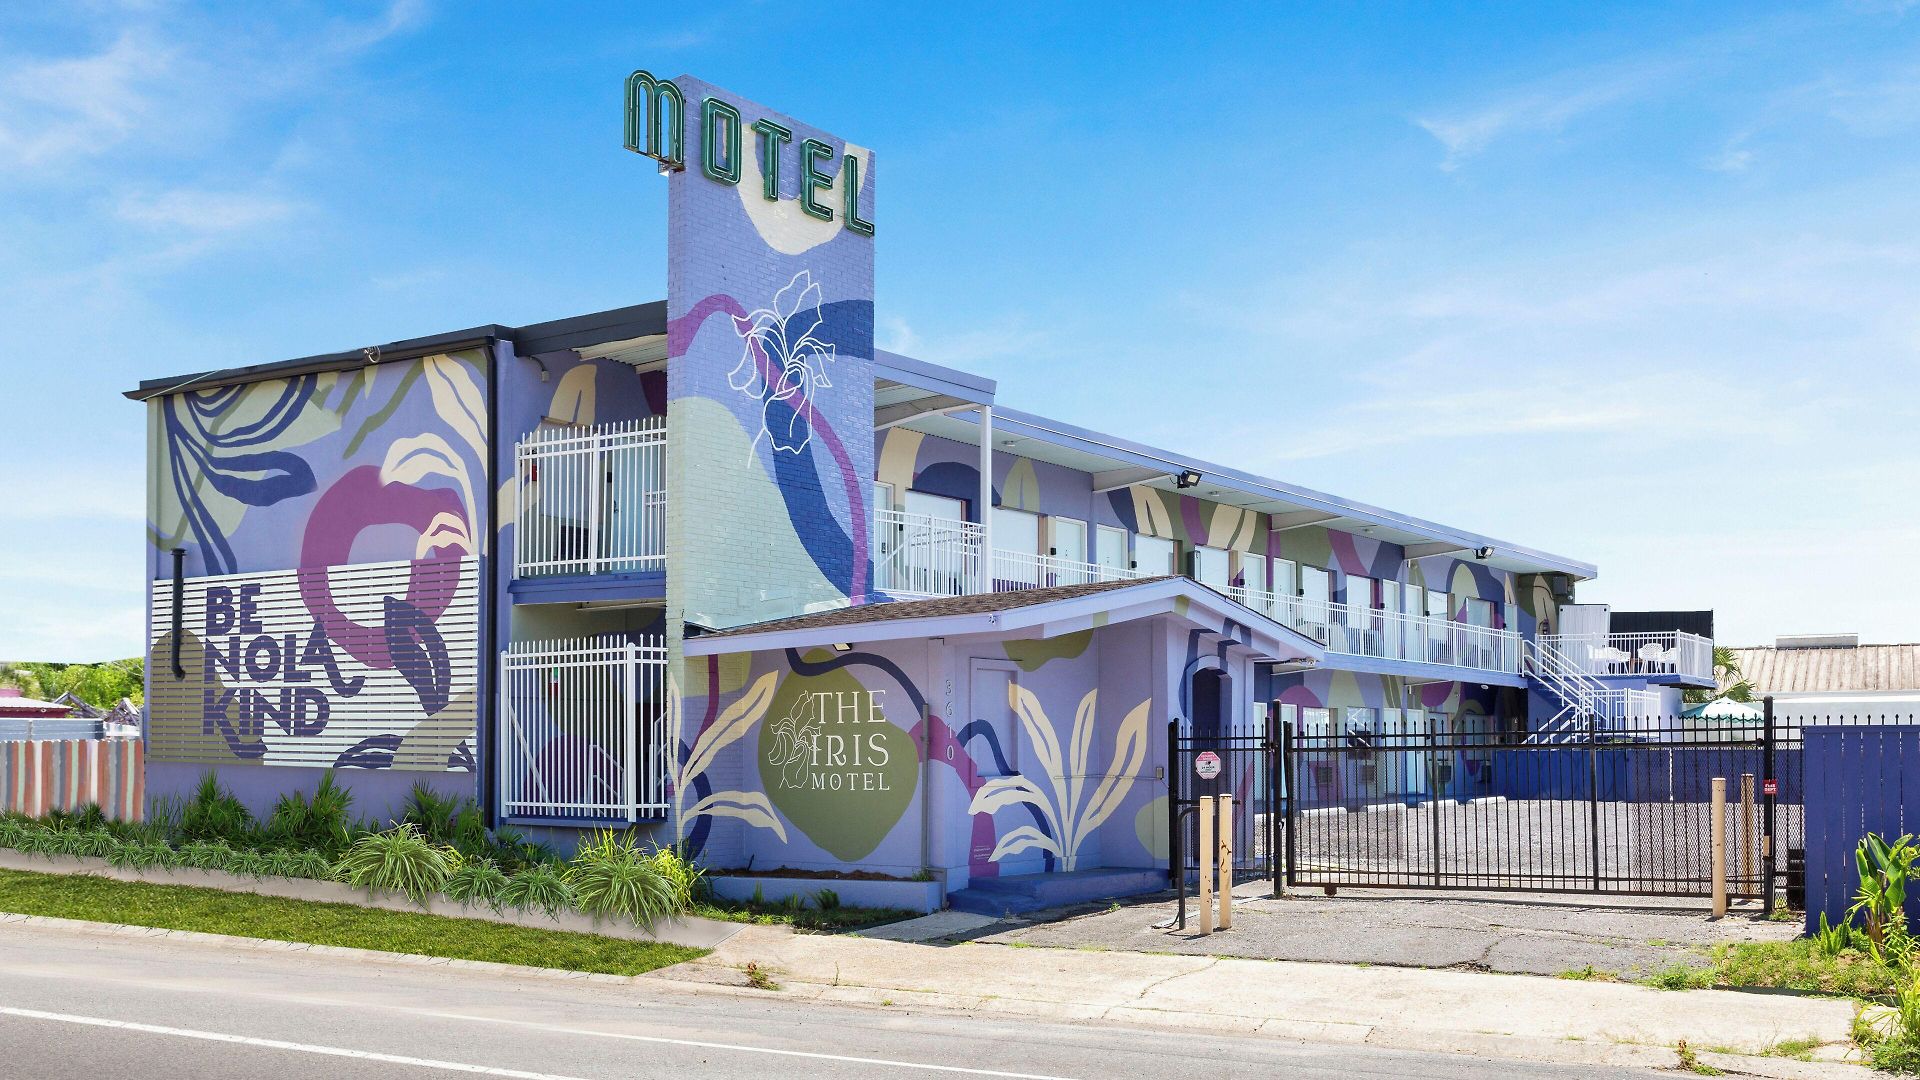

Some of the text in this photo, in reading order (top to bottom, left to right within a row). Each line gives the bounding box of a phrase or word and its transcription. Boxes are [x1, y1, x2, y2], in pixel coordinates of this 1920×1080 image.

[624, 69, 875, 237] MOTEL
[206, 583, 263, 636] BE
[204, 616, 366, 698] NOLA
[203, 687, 330, 759] KIND
[812, 689, 886, 724] THE
[945, 679, 954, 761] 3610
[810, 733, 890, 767] IRIS
[811, 772, 890, 791] MOTEL
